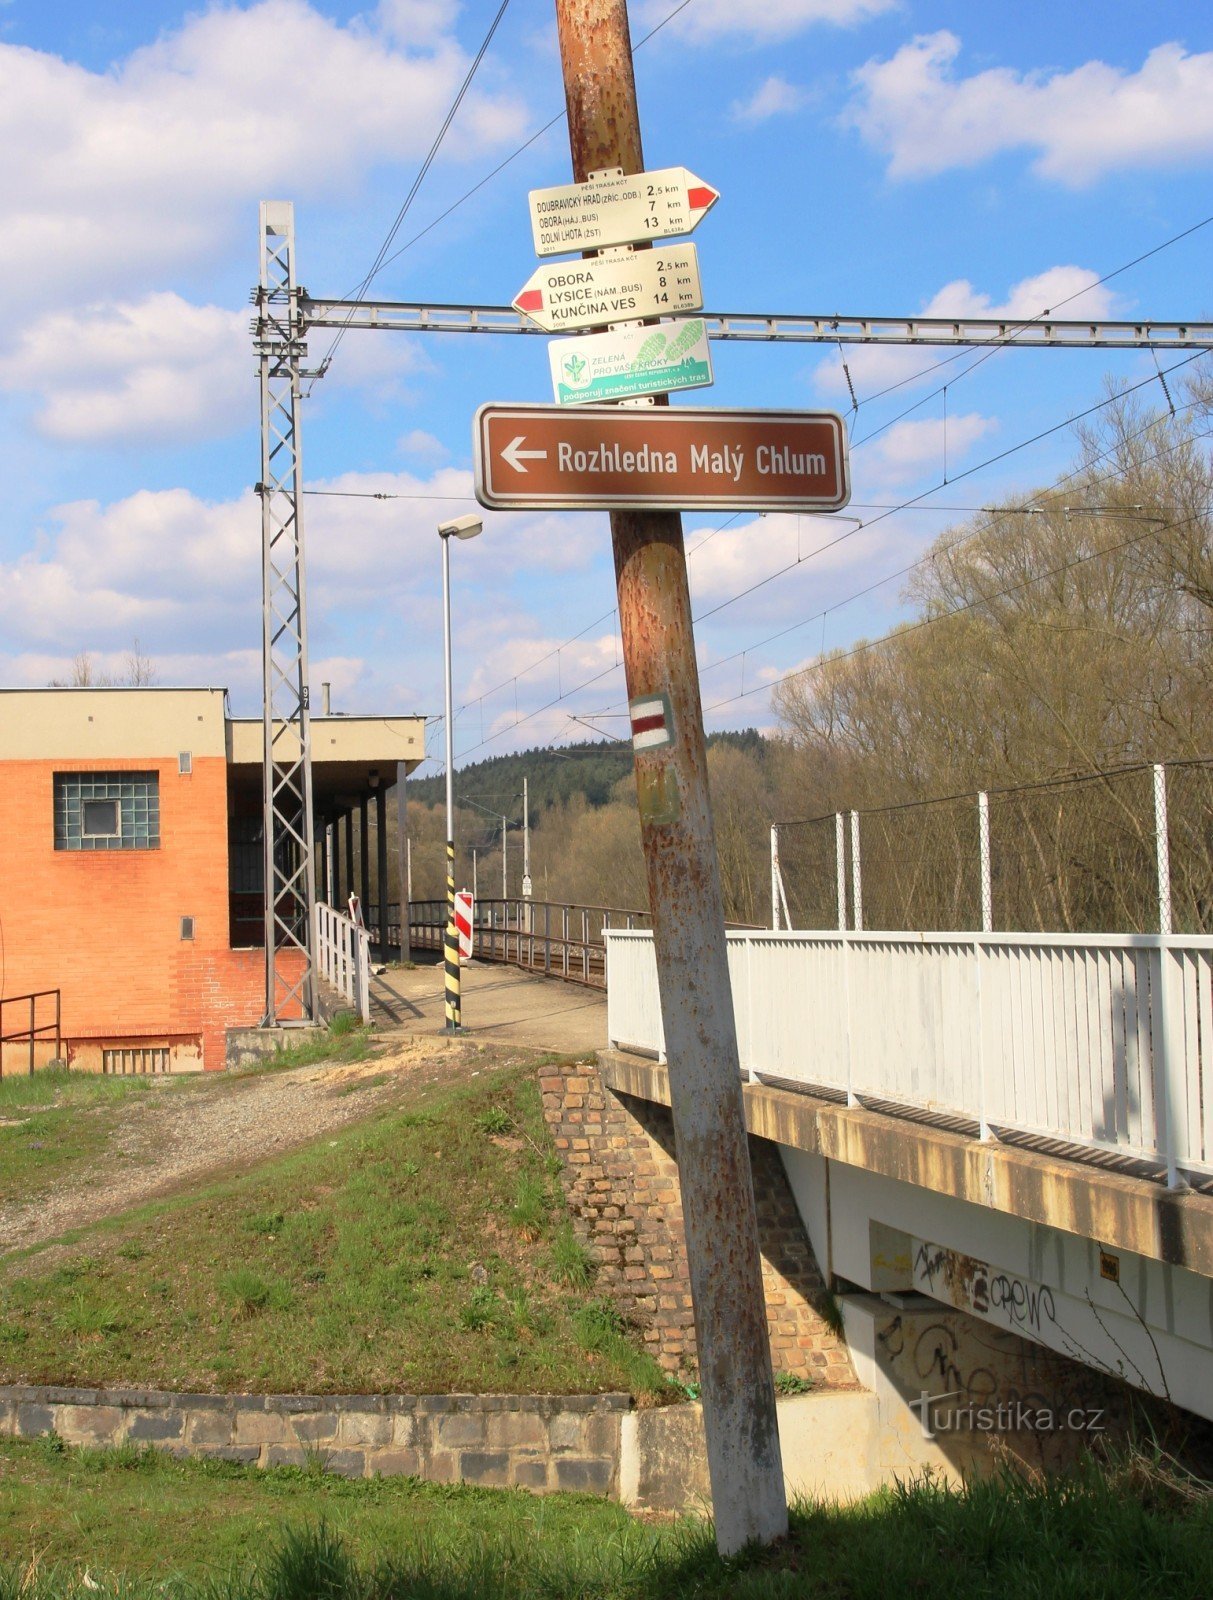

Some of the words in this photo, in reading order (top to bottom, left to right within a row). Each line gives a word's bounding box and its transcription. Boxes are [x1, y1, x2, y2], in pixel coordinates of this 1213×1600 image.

[537, 194, 582, 213] DOUBRAVICKÝ
[647, 186, 662, 196] 2,5
[595, 182, 615, 190] TRASA
[539, 218, 562, 229] OBORA
[649, 201, 655, 211] 7
[541, 230, 560, 244] DOLNÍ
[561, 228, 583, 242] LHOTA
[584, 228, 601, 240] (ŽST)
[644, 217, 659, 228] 13
[548, 272, 594, 288] OBORA
[657, 261, 672, 272] 2,5
[675, 261, 688, 270] km
[605, 257, 625, 265] TRASA
[549, 288, 592, 304] LYSICE
[659, 277, 667, 287] 8
[677, 277, 691, 285] km
[551, 300, 608, 320] KUNČINA
[611, 298, 636, 310] VES
[653, 293, 668, 304] 14
[679, 292, 693, 301] km
[592, 352, 625, 365] ZELENÁ
[593, 366, 612, 376] PRO
[614, 362, 636, 374] VAŠE
[638, 358, 668, 369] KROKY
[564, 387, 603, 401] podporují
[605, 382, 637, 394] značení
[639, 376, 688, 391] turistických
[690, 373, 706, 382] tras
[558, 442, 678, 473] Rozhledna
[690, 444, 744, 482] Malý
[756, 446, 826, 475] Chlum
